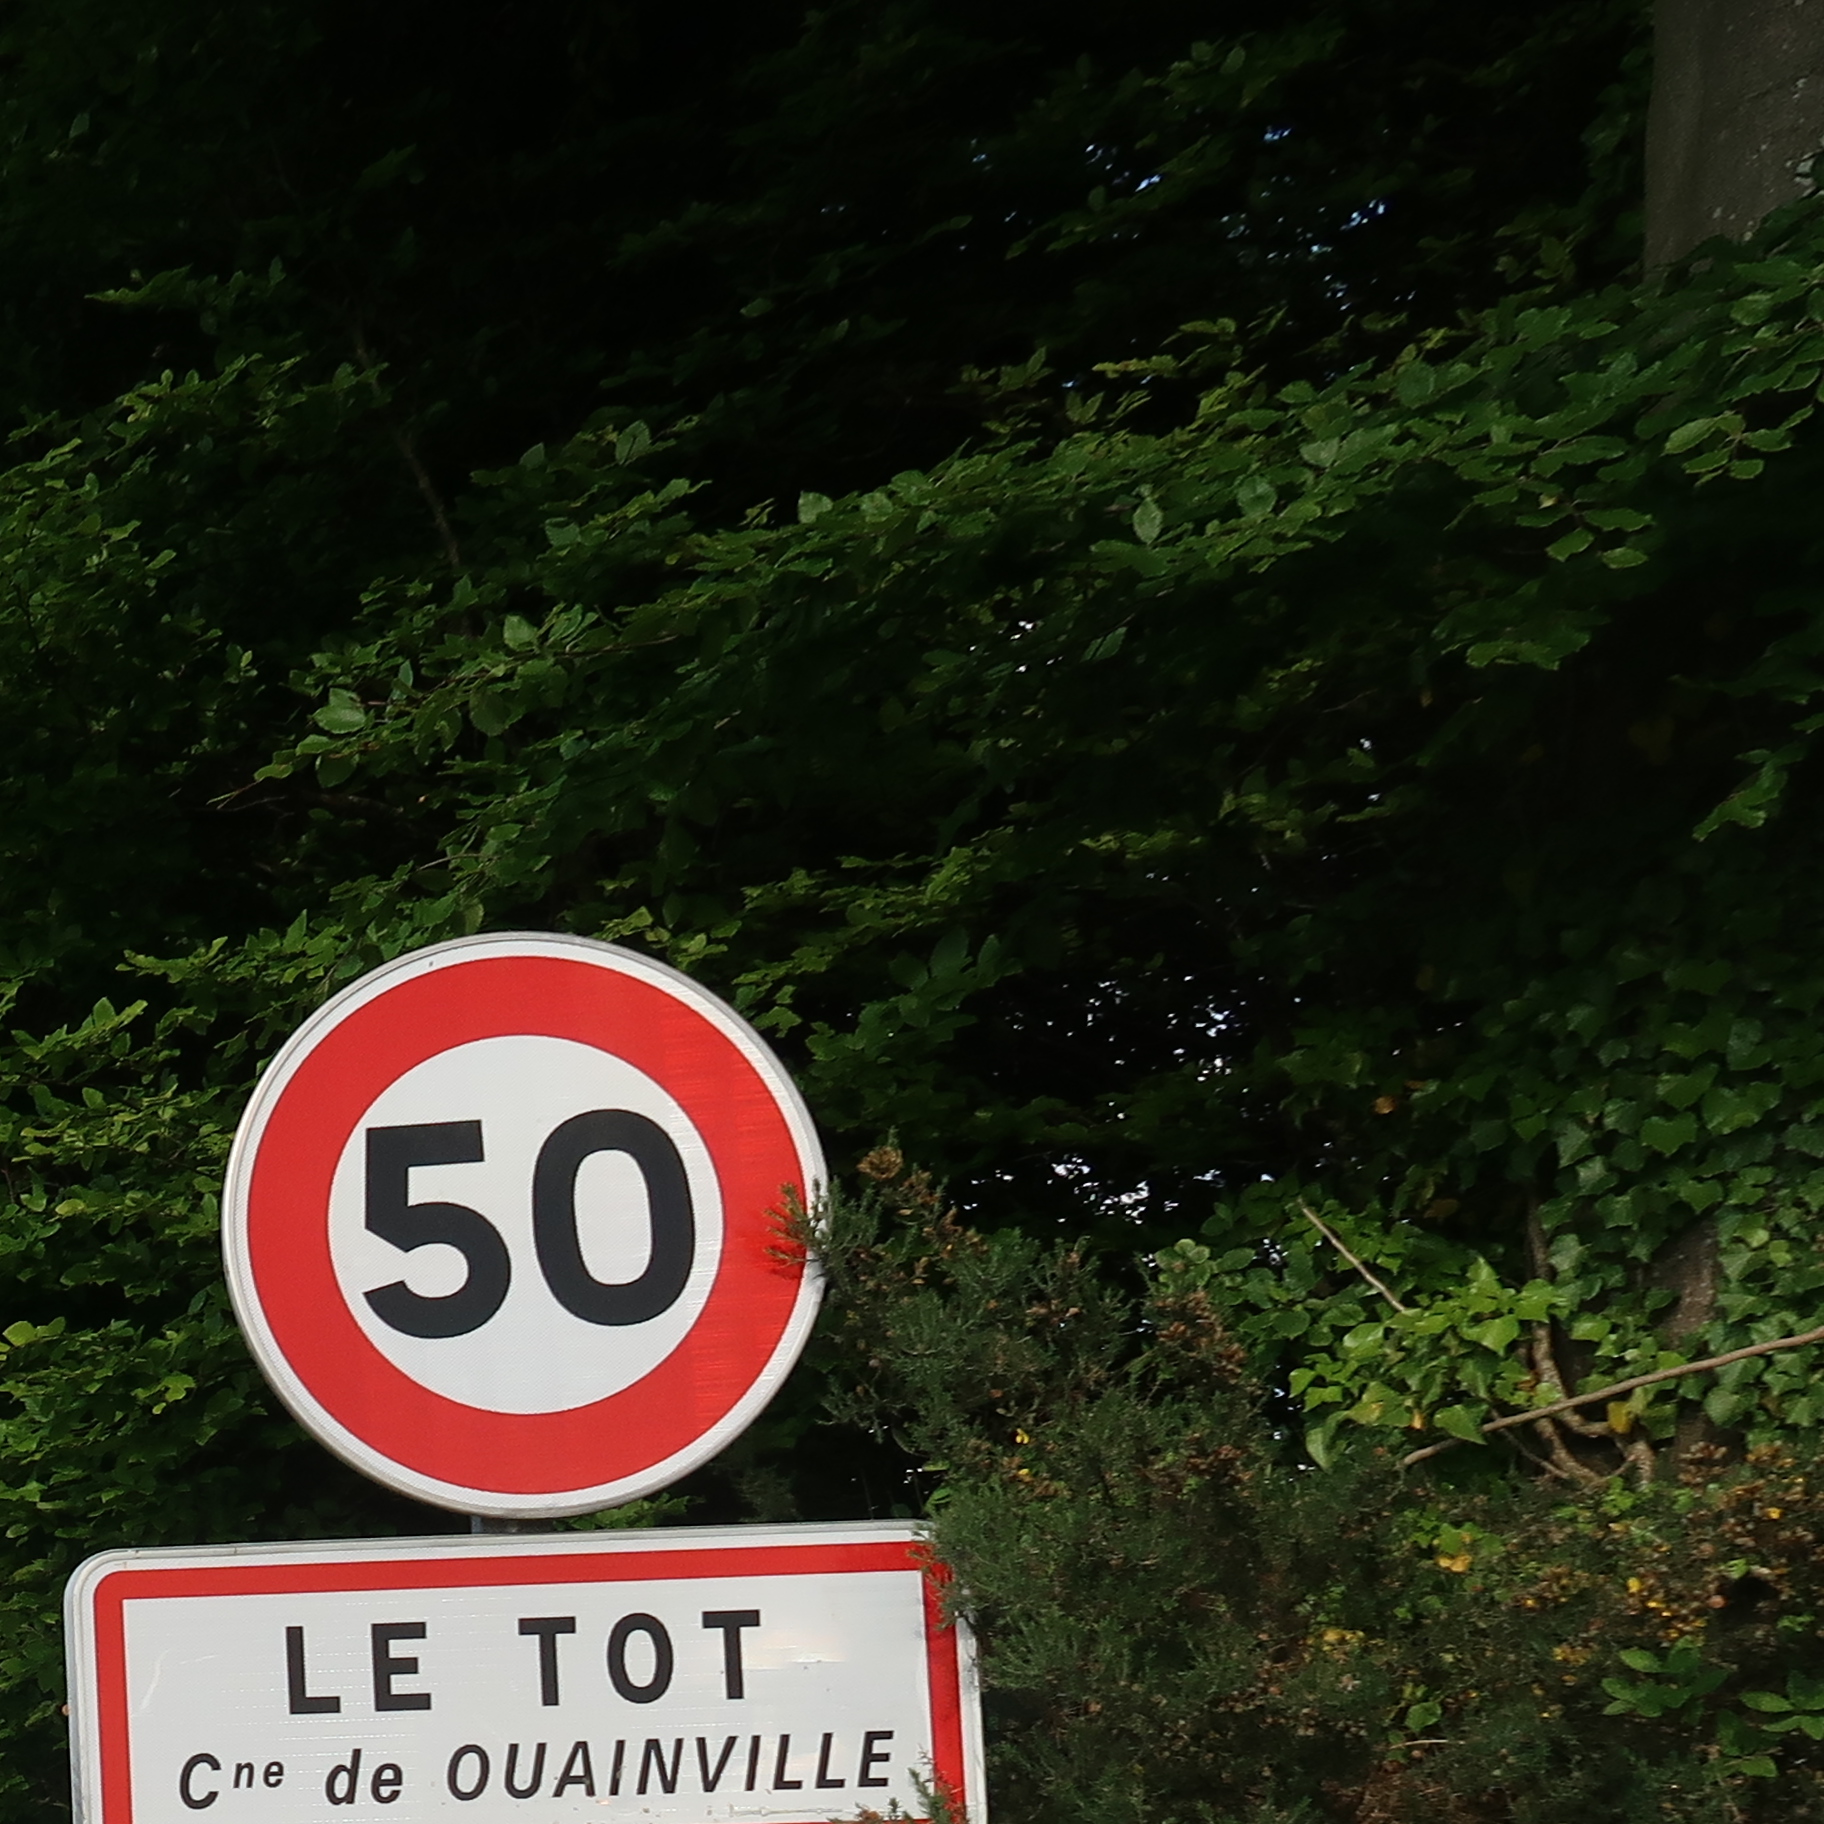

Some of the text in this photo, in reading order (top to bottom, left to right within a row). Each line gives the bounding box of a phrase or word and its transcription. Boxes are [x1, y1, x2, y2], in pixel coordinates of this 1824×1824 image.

[362, 1108, 696, 1340] 50
[285, 1609, 761, 1715] LE TOT
[325, 1748, 404, 1806] de
[447, 1730, 895, 1801] OUAINVILLE
